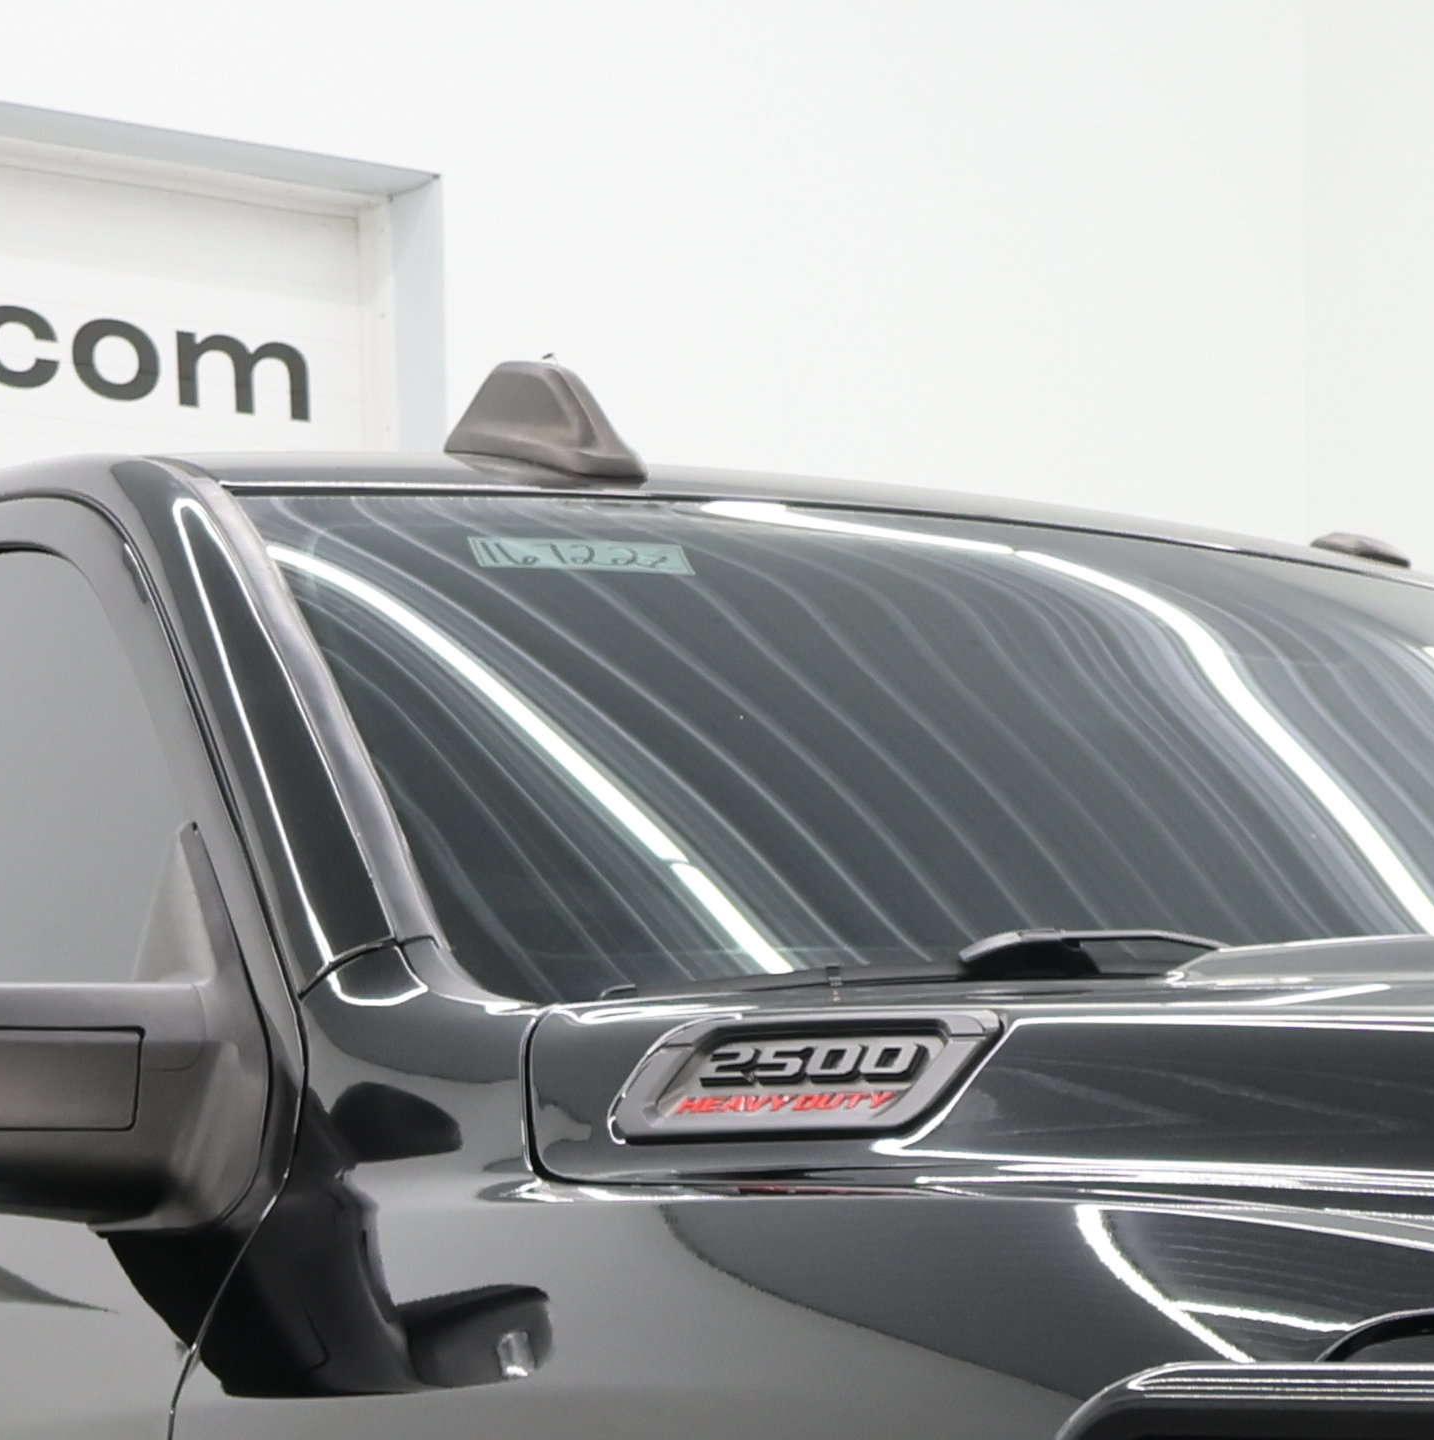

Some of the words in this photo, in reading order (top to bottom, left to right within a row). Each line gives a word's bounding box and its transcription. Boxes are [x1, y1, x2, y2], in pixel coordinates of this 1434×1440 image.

[700, 1042, 928, 1086] 2500
[674, 1093, 791, 1115] HEAVY
[790, 1090, 896, 1112] DUTY
